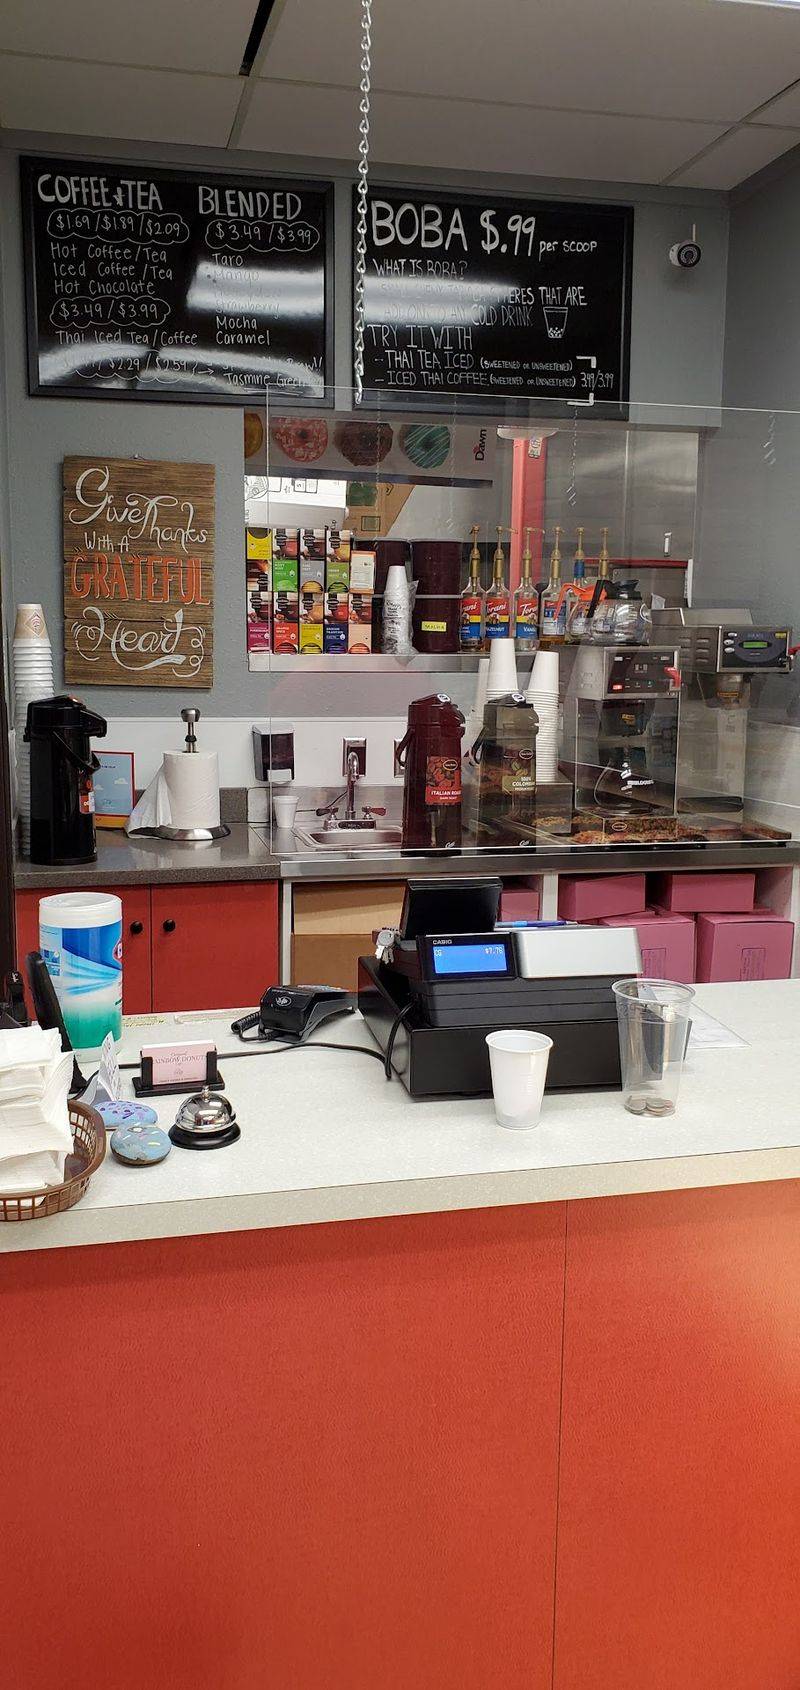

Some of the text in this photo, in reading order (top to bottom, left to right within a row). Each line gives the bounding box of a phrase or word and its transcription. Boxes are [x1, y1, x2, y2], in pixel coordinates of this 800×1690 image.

[37, 173, 112, 207] COFFEE
[120, 180, 163, 211] TEA
[198, 186, 302, 220] BLENDED
[370, 199, 468, 251] BOBA
[480, 208, 536, 257] $.99
[539, 240, 559, 262] per
[50, 241, 77, 259] Hot
[211, 252, 244, 267] Taro
[53, 260, 86, 277] Iced
[97, 261, 135, 277] Coffee
[372, 258, 468, 281] WHAT IS BOBA?
[54, 279, 156, 295] Hot Chocolate
[538, 286, 563, 305] THAT
[564, 286, 588, 306] ARE
[215, 315, 258, 330] Mocha
[470, 303, 498, 327] COLD
[500, 305, 534, 328] DRINK
[55, 329, 86, 345] Thai
[94, 328, 122, 344] Iced
[215, 330, 270, 345] Caramel
[366, 324, 473, 350] TRY IT WITH
[384, 349, 475, 370] THAI TEA ICED
[223, 372, 271, 386] Jasmine
[386, 370, 417, 386] ICED
[420, 371, 444, 386] THAI
[446, 371, 487, 387] COFFEE
[475, 429, 487, 461] Dawn
[69, 466, 208, 554] Give Thanks
[84, 531, 130, 553] With A
[71, 551, 210, 605] GRATEFUL
[82, 607, 187, 671] Heart
[153, 1056, 181, 1064] AINBOW
